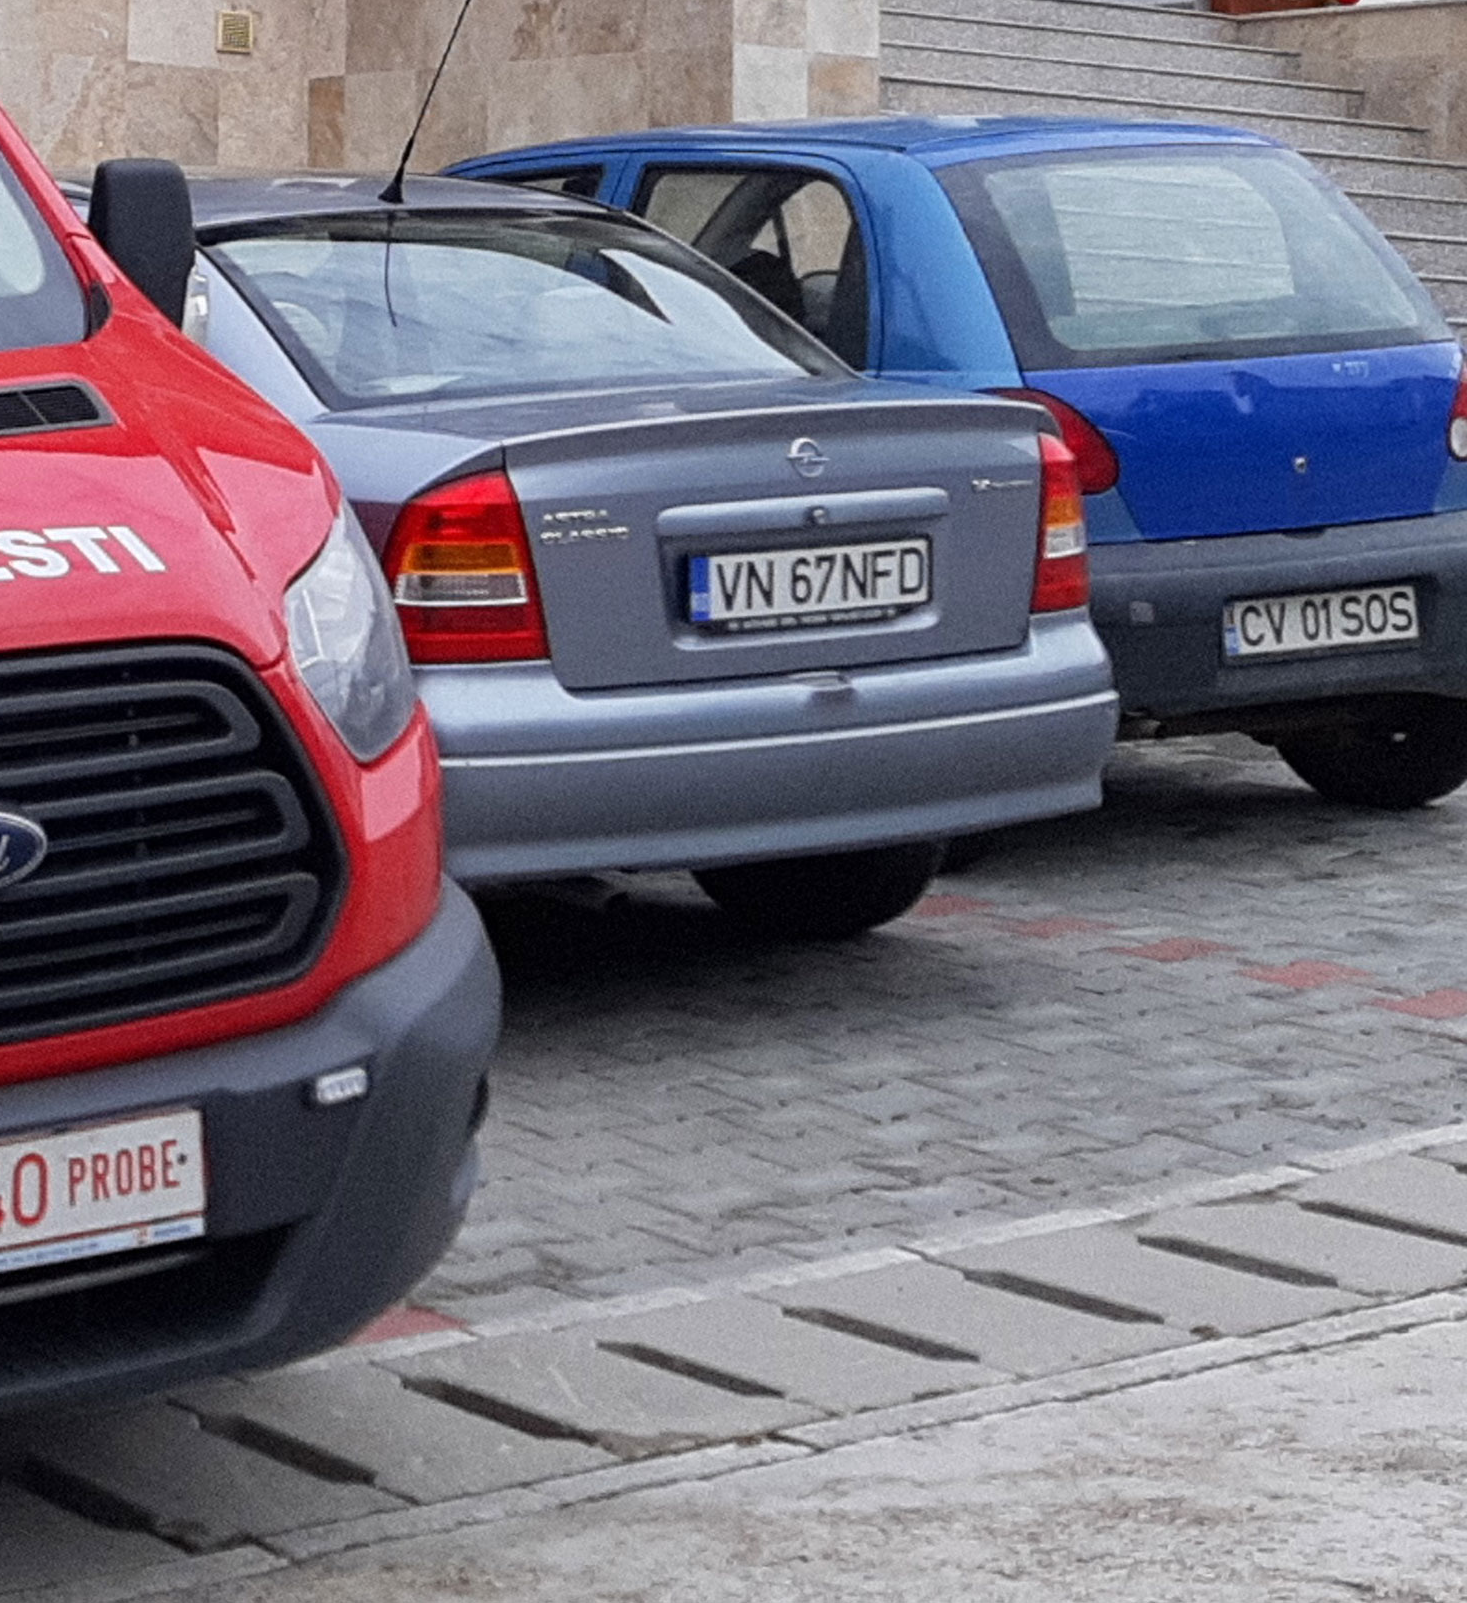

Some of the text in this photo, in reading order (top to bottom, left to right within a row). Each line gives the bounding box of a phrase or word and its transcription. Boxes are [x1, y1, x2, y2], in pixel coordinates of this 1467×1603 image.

[717, 547, 925, 611] VN 67NFD
[1240, 591, 1414, 647] CV 01 SOS
[68, 1139, 180, 1207] PROBE
